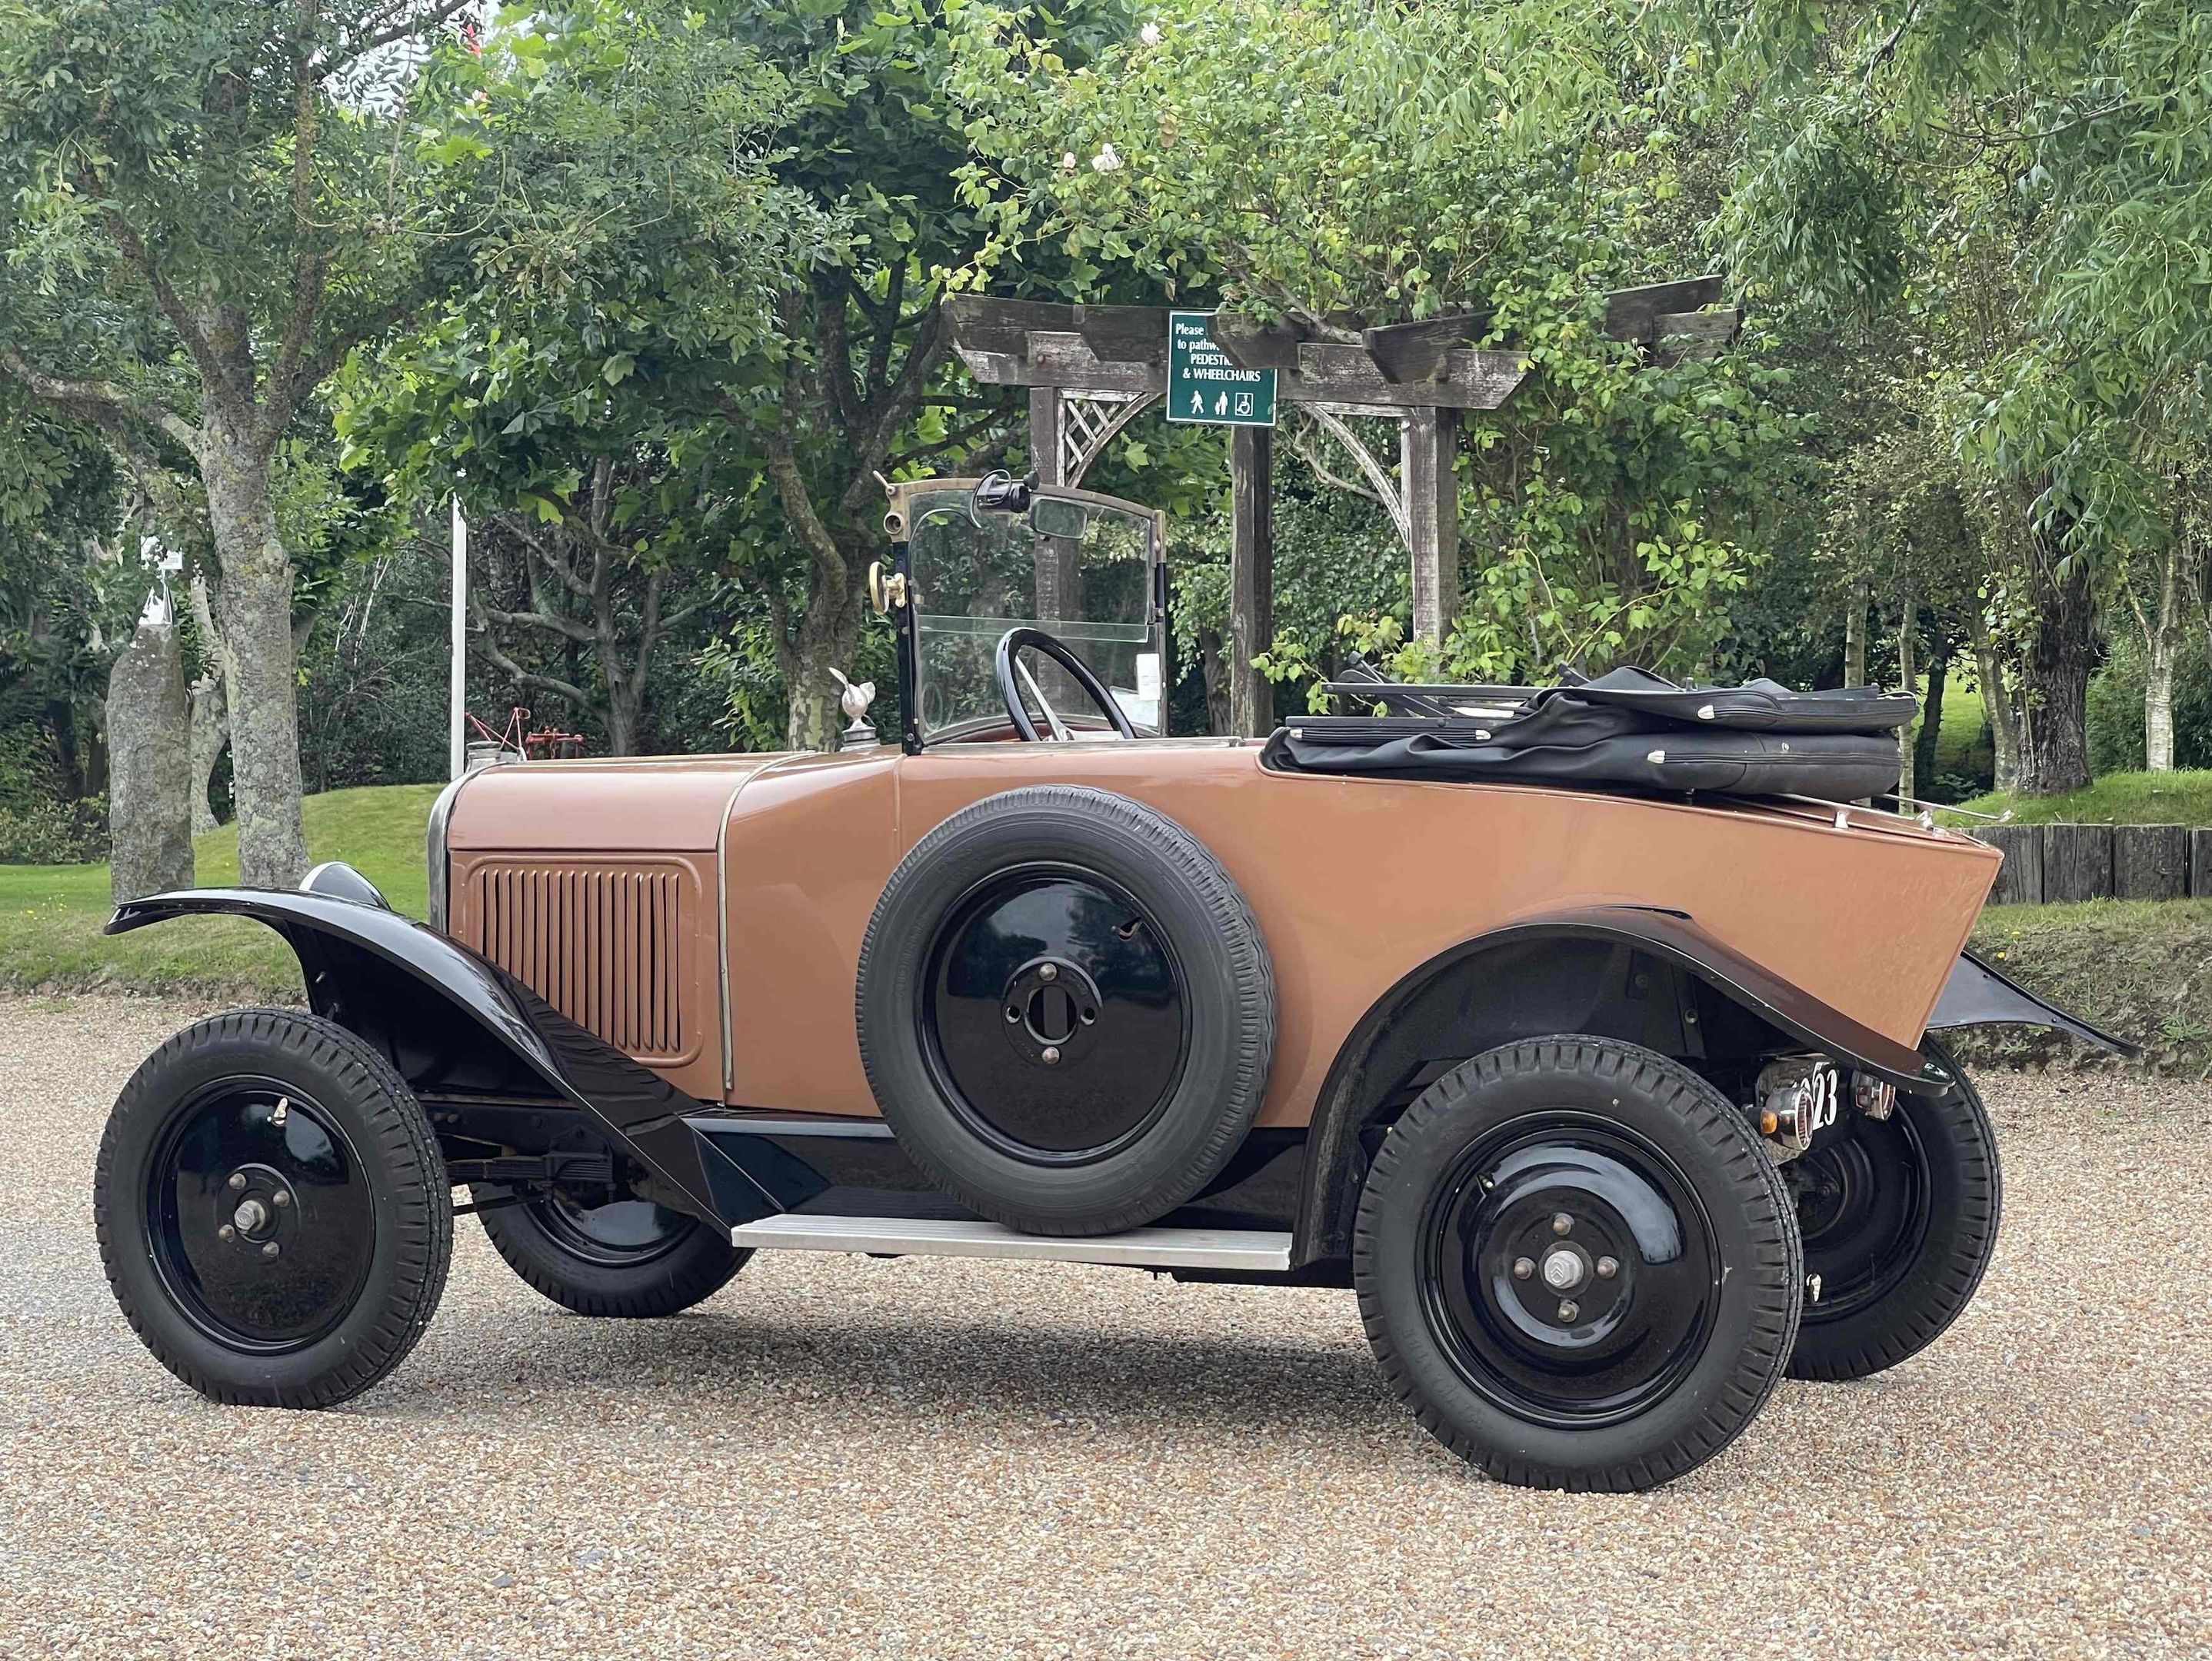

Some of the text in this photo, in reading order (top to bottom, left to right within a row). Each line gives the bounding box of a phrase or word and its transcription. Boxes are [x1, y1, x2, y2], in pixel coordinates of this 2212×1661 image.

[1175, 323, 1204, 335] Please
[1178, 339, 1187, 349] to
[1182, 368, 1261, 382] & WHEELCHAIRS
